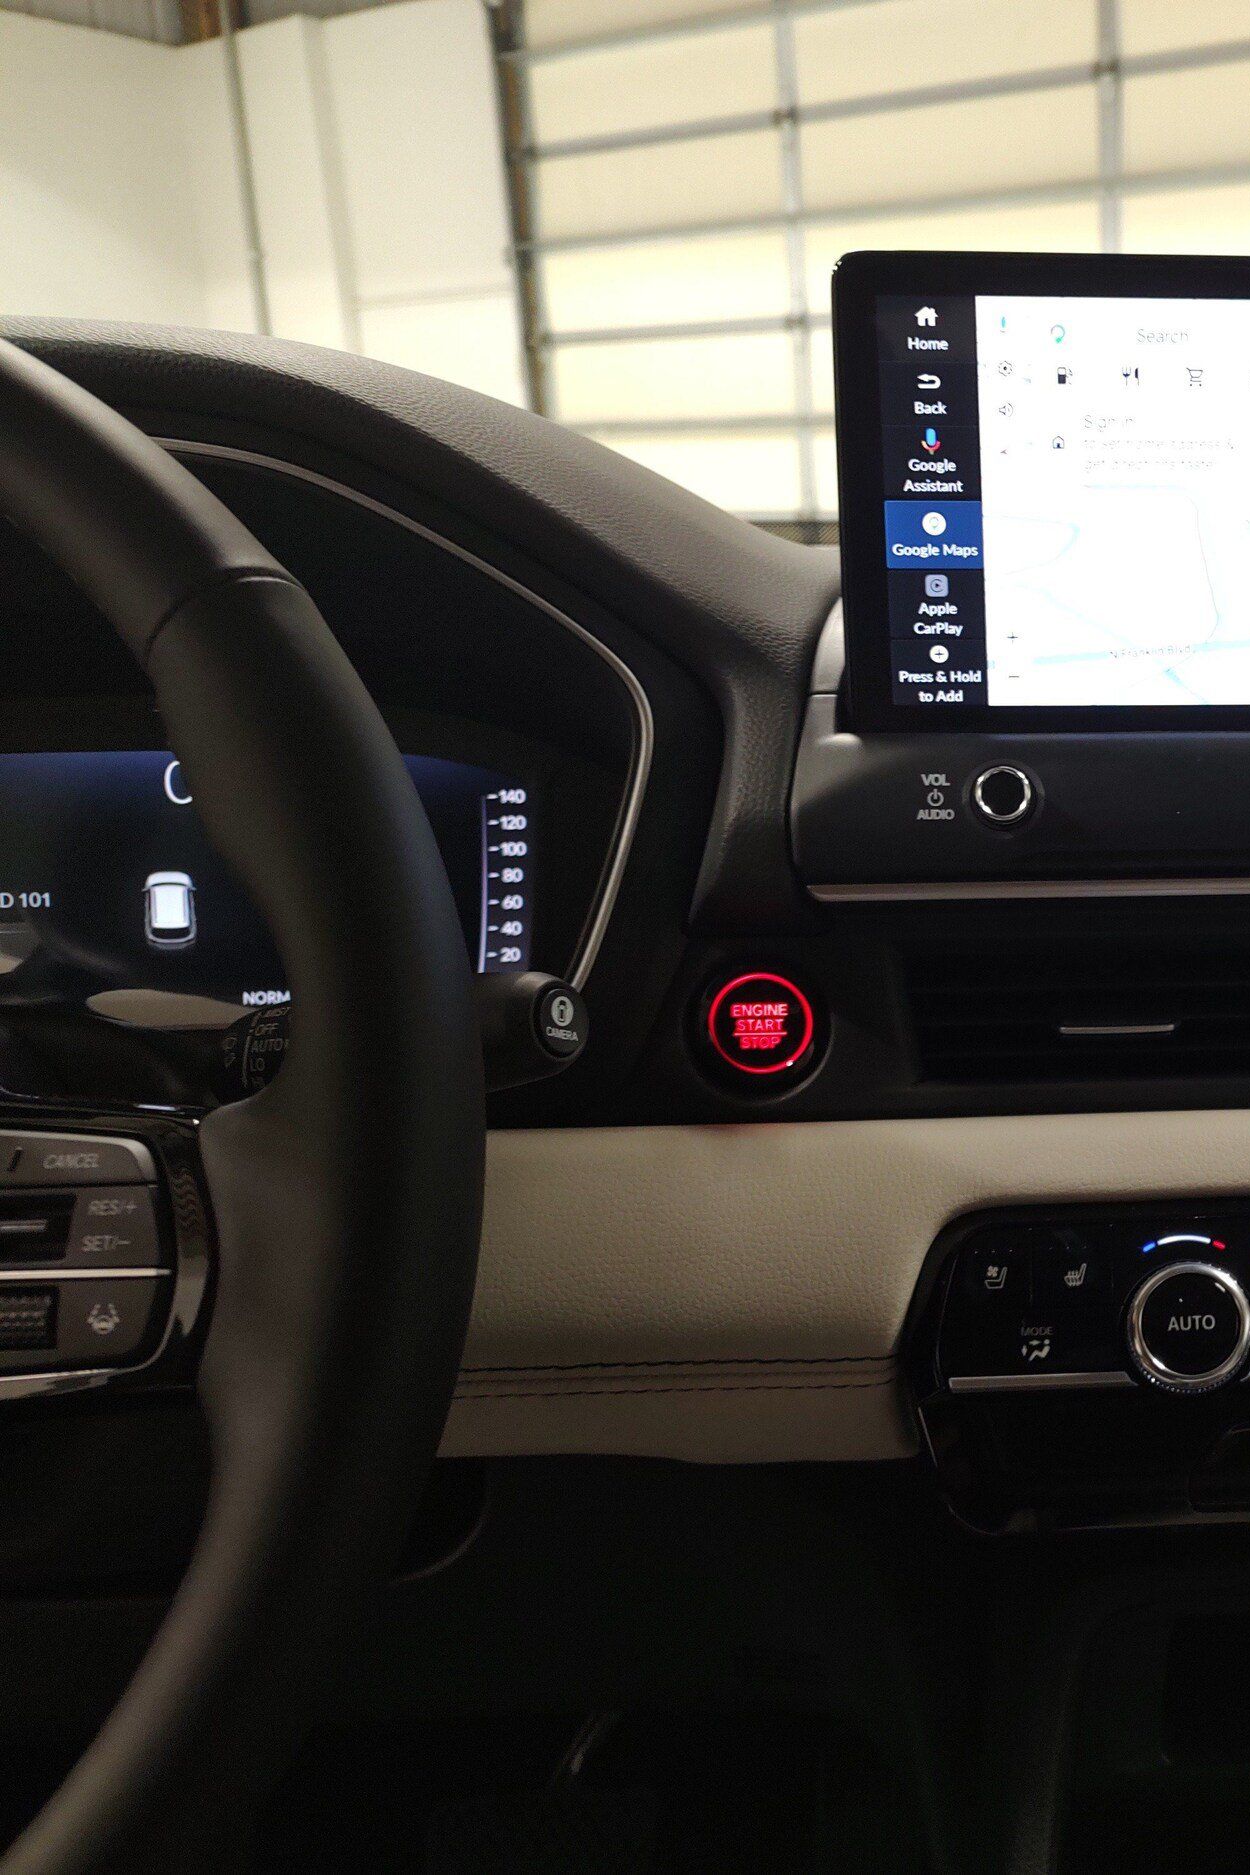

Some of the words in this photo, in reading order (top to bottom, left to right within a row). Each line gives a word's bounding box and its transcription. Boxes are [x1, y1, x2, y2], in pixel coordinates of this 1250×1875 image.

[1137, 328, 1189, 343] Search
[907, 337, 949, 350] Home
[914, 402, 947, 415] Back
[908, 459, 956, 474] Google
[903, 479, 964, 493] Assistant
[892, 543, 940, 558] Google
[943, 544, 979, 558] Maps
[918, 602, 958, 616] Apple
[913, 622, 963, 636] CarPlay
[898, 670, 933, 683] Press
[935, 671, 947, 683] &
[950, 670, 982, 683] Hold
[918, 691, 933, 702] to
[935, 690, 963, 702] Add
[920, 774, 950, 786] VOL
[499, 789, 527, 804] 140
[916, 809, 955, 820] AUDIO
[499, 815, 527, 830] 120
[500, 841, 527, 856] 100
[501, 867, 524, 883] 80
[19, 892, 50, 908] 101
[501, 894, 524, 910] 60
[500, 920, 523, 936] 40
[499, 947, 521, 962] 20
[733, 1003, 788, 1017] ENGINE
[736, 1018, 784, 1031] START
[546, 1026, 579, 1041] CAMERA
[741, 1036, 781, 1049] STOP
[43, 1153, 99, 1169] CANCEL
[1168, 1314, 1216, 1331] AUTO
[1021, 1326, 1053, 1336] MODE
